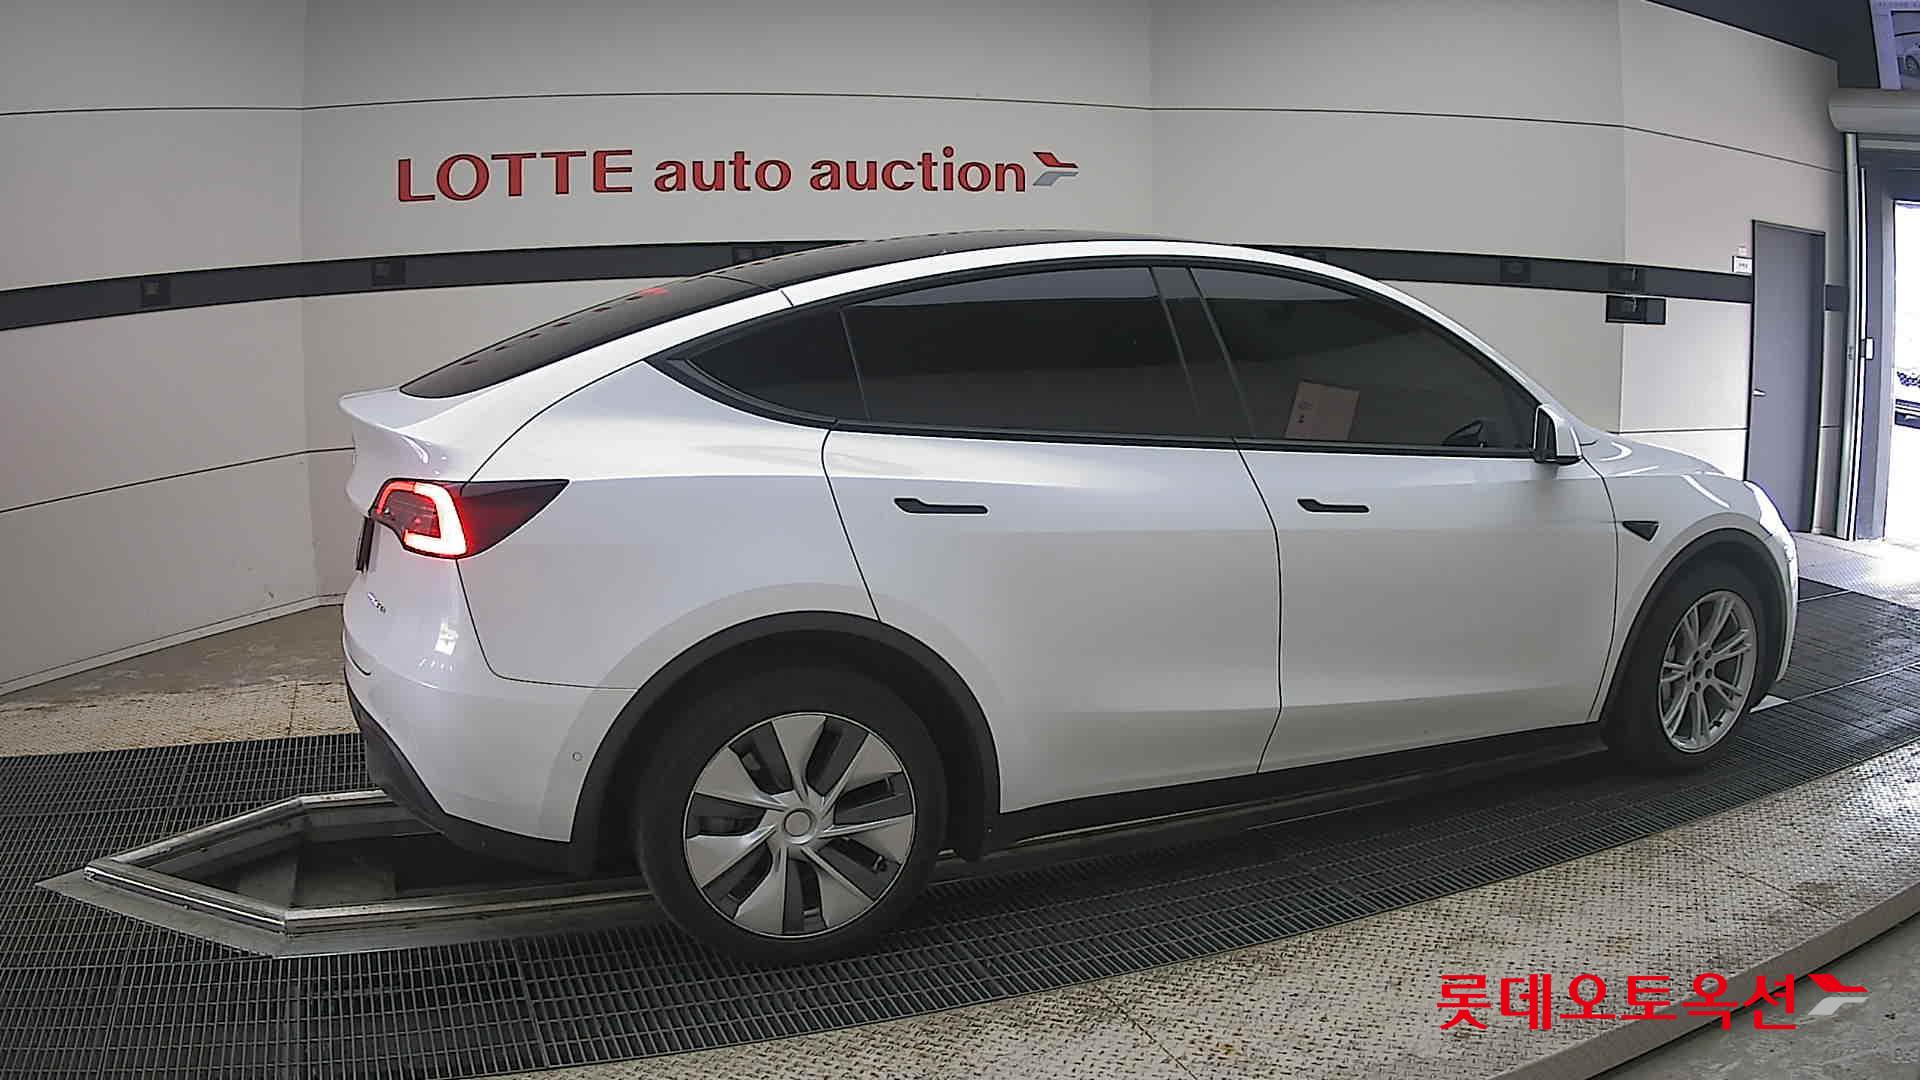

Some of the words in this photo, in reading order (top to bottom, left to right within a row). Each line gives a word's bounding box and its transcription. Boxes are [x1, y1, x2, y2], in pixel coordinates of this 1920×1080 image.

[397, 149, 633, 203] LOTTE
[654, 150, 793, 193] auto
[808, 145, 1027, 193] auction
